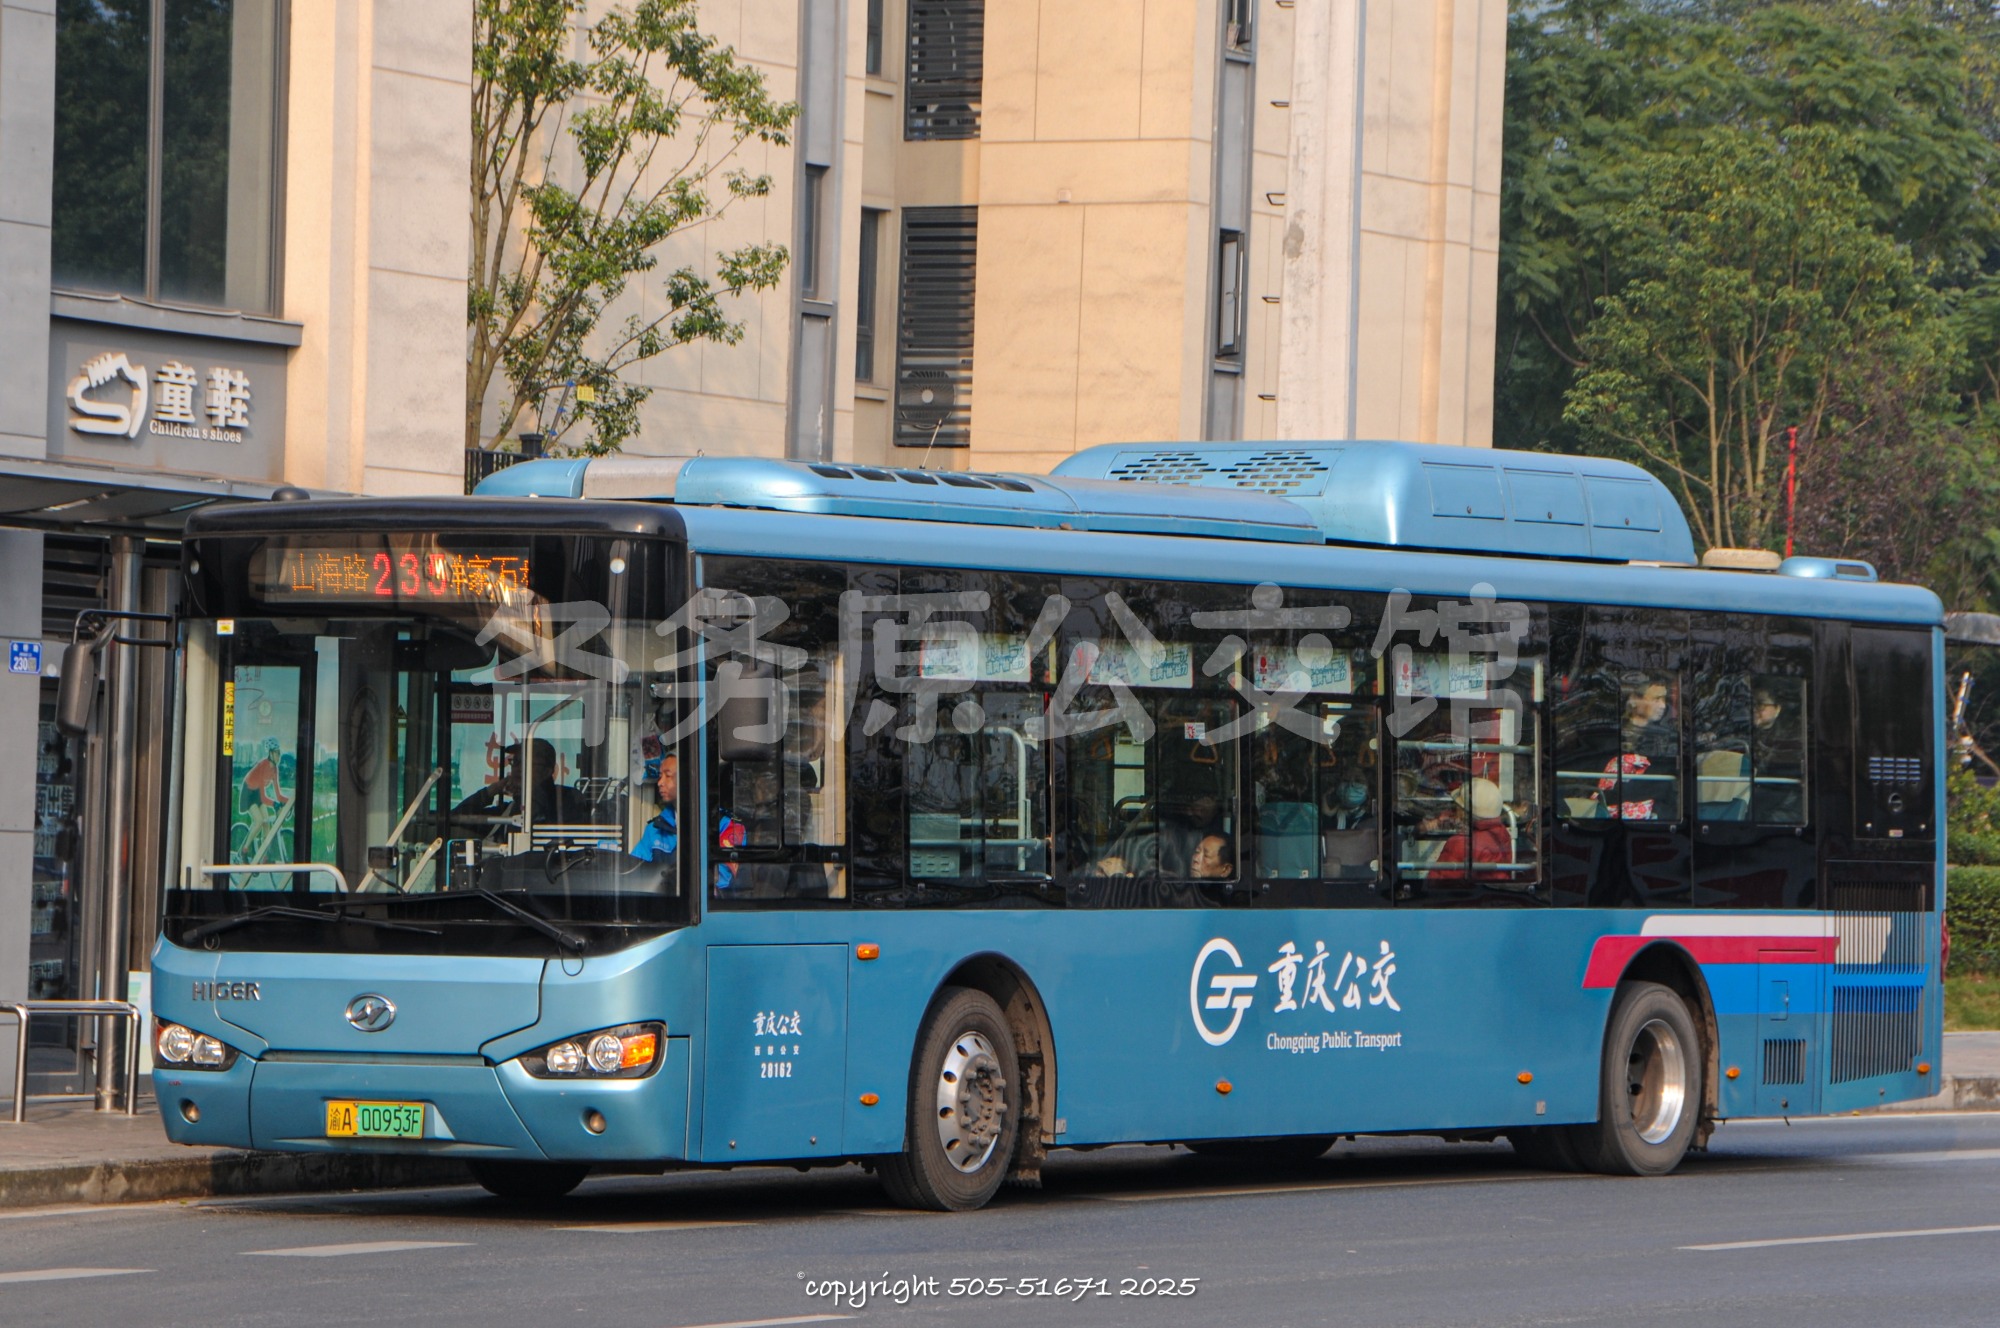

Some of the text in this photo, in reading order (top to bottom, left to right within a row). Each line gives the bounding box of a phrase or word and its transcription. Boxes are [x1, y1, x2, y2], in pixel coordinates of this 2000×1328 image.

[153, 361, 251, 428] 童鞋
[149, 420, 200, 439] Children
[210, 427, 242, 443] shoes
[291, 553, 369, 595] 山海路
[223, 704, 234, 752] 禁止手扶
[192, 981, 260, 1002] HIGER
[1268, 940, 1401, 1013] 重庆公交
[752, 1010, 802, 1036] 重庆公交
[1267, 1031, 1402, 1054] Chongqing Public Transport
